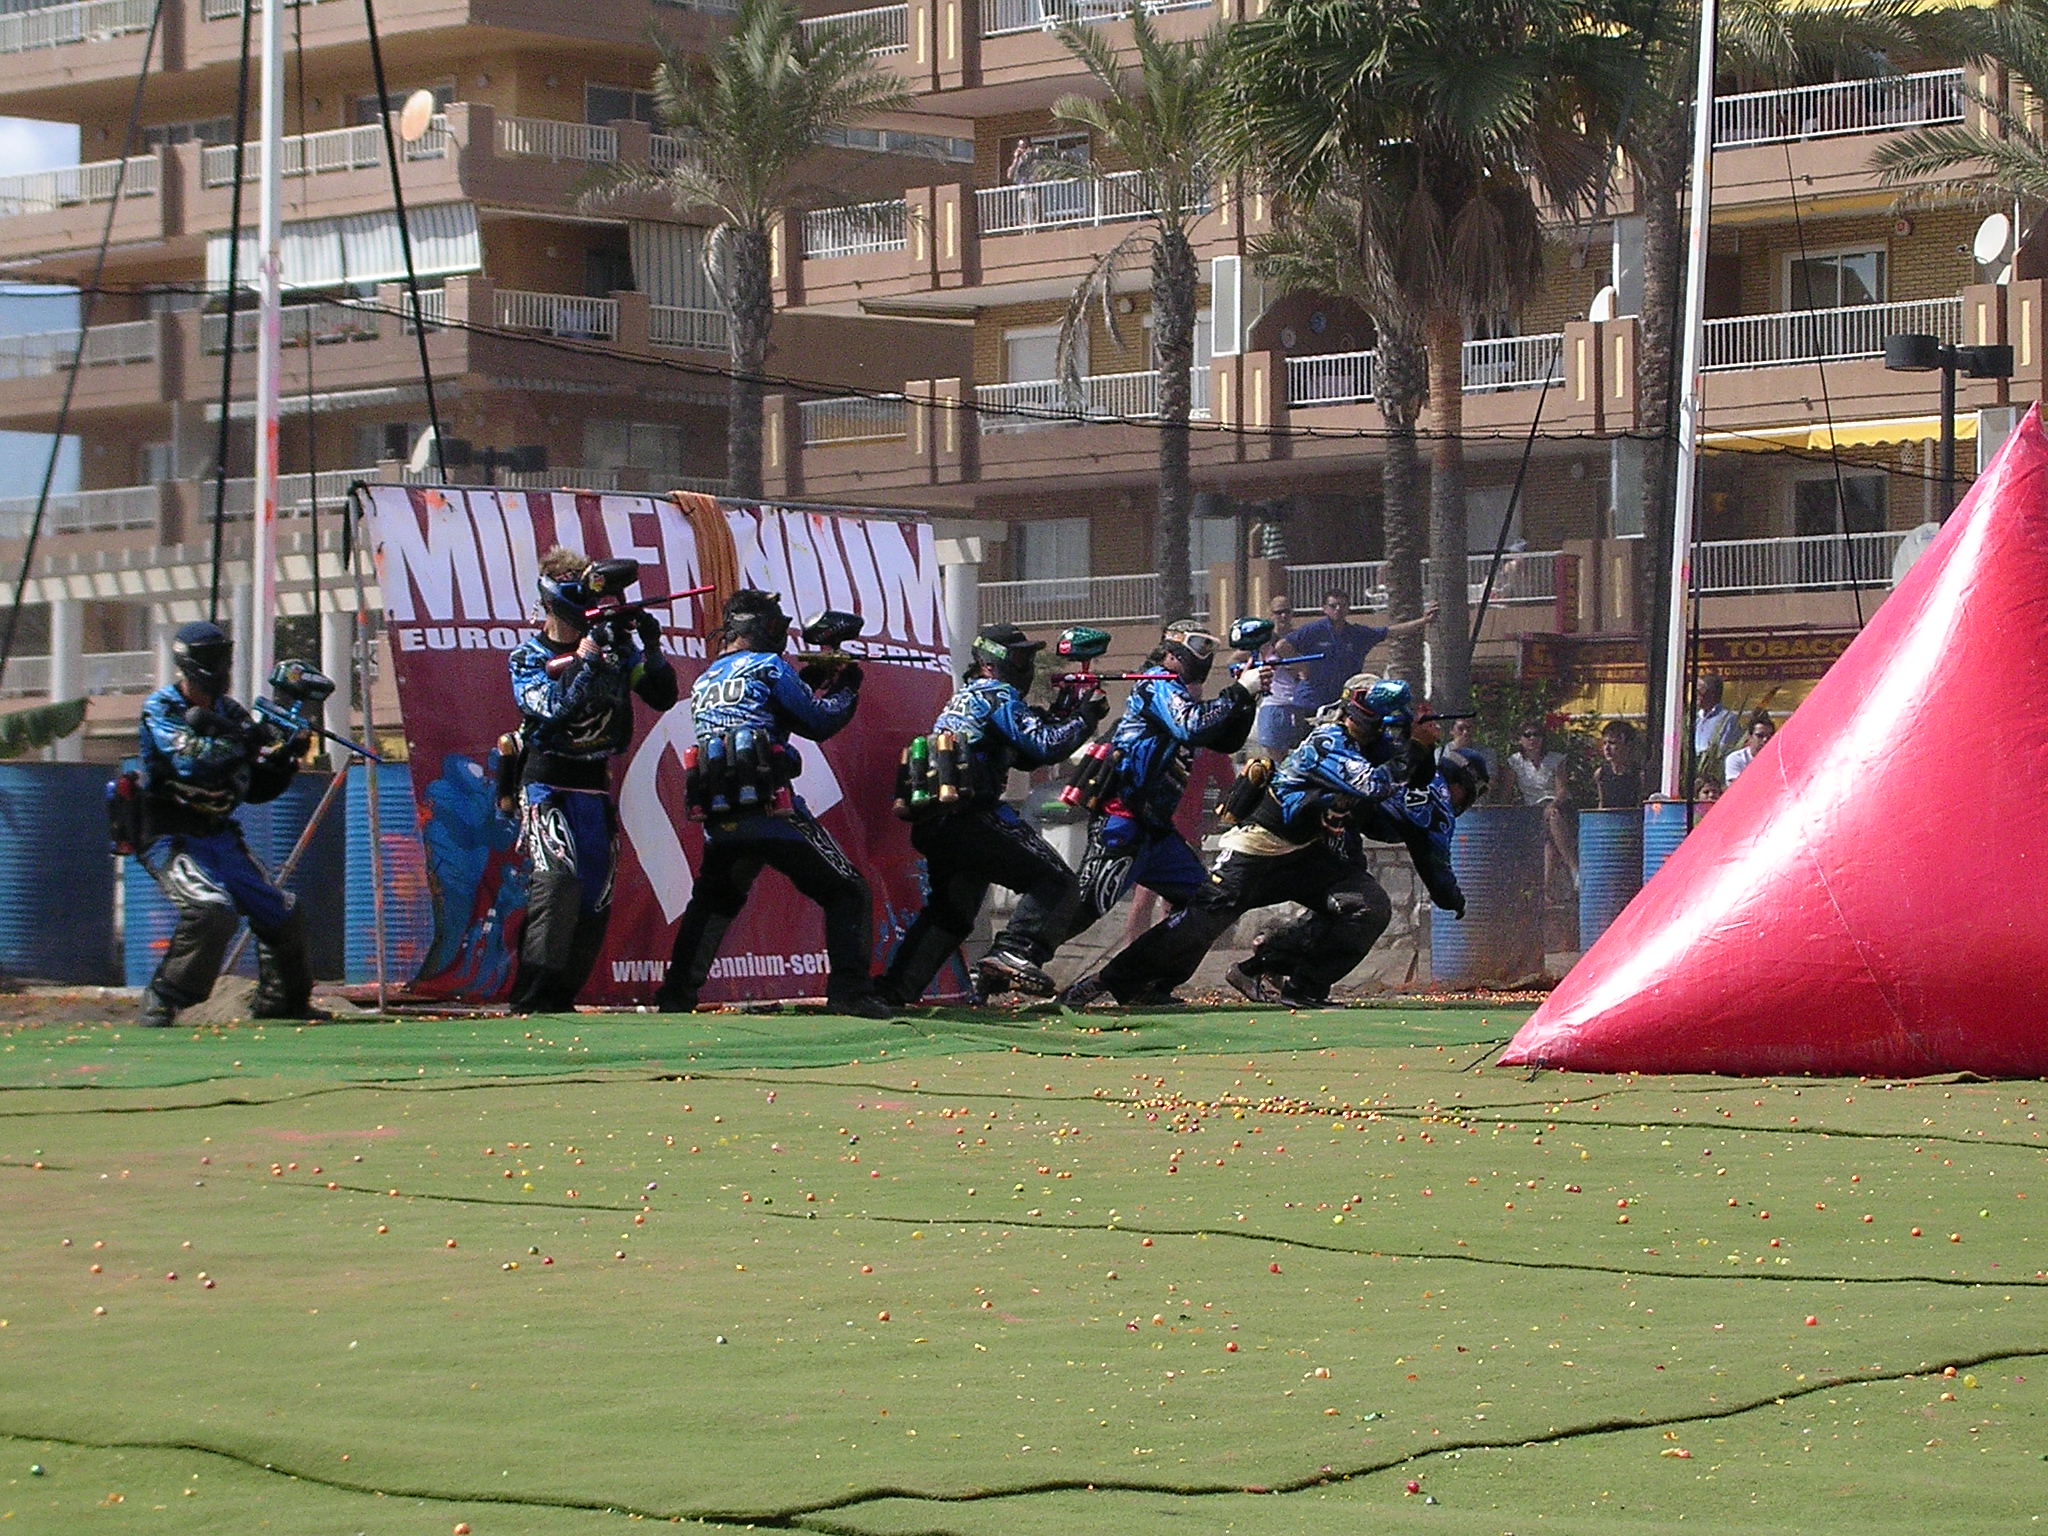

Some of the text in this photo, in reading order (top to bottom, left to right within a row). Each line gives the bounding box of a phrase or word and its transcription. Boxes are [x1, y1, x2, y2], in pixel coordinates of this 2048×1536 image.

[840, 640, 952, 675] SERIES
[1727, 637, 1850, 658] TOBACC
[1717, 666, 1768, 676] TOBACCO
